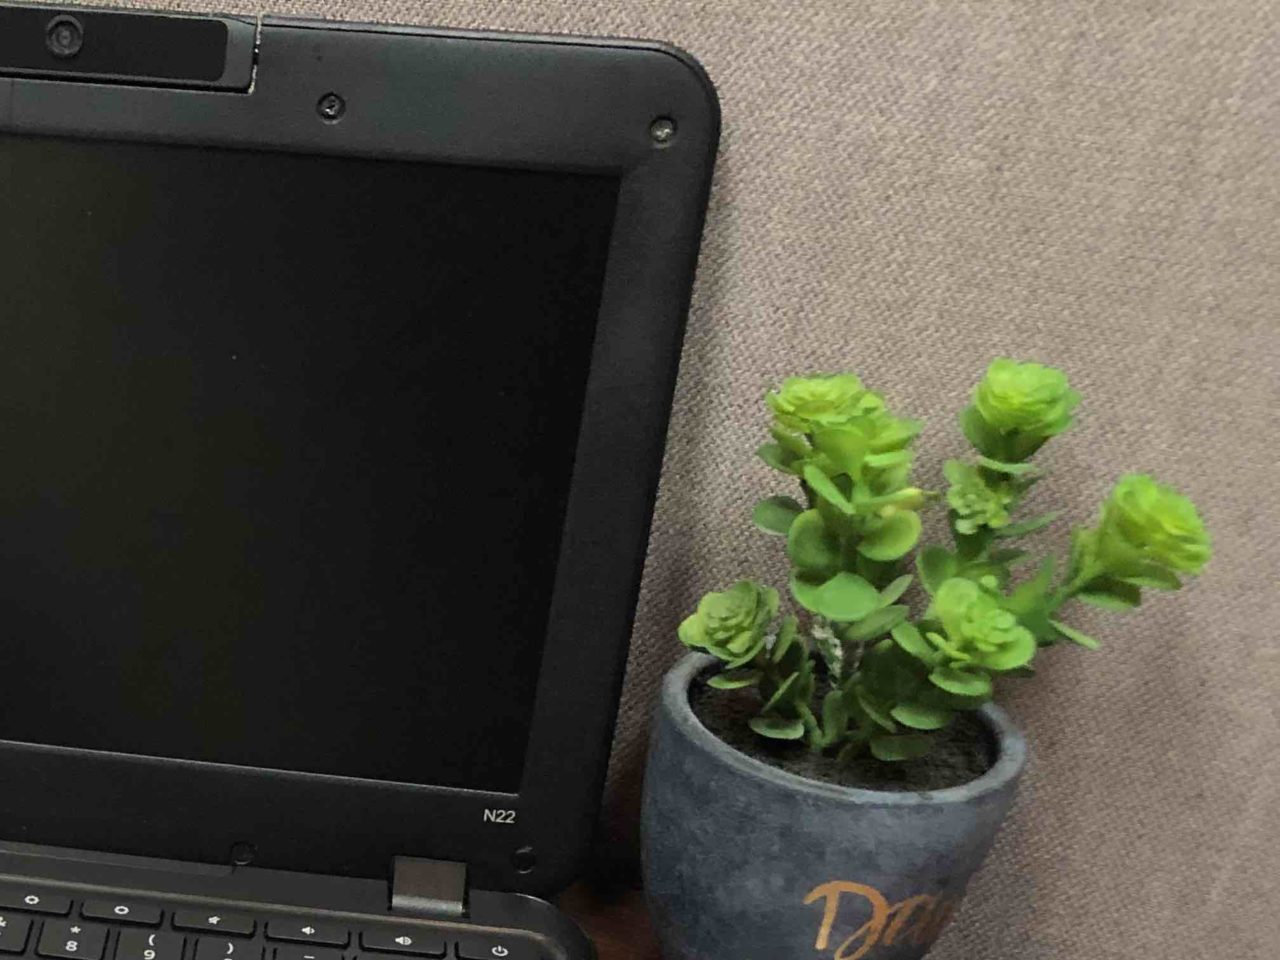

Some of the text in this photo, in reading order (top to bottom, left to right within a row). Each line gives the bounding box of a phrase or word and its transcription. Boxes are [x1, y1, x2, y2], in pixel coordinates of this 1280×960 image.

[483, 808, 516, 824] N22
[65, 940, 78, 952] 8
[143, 949, 156, 960] 9
